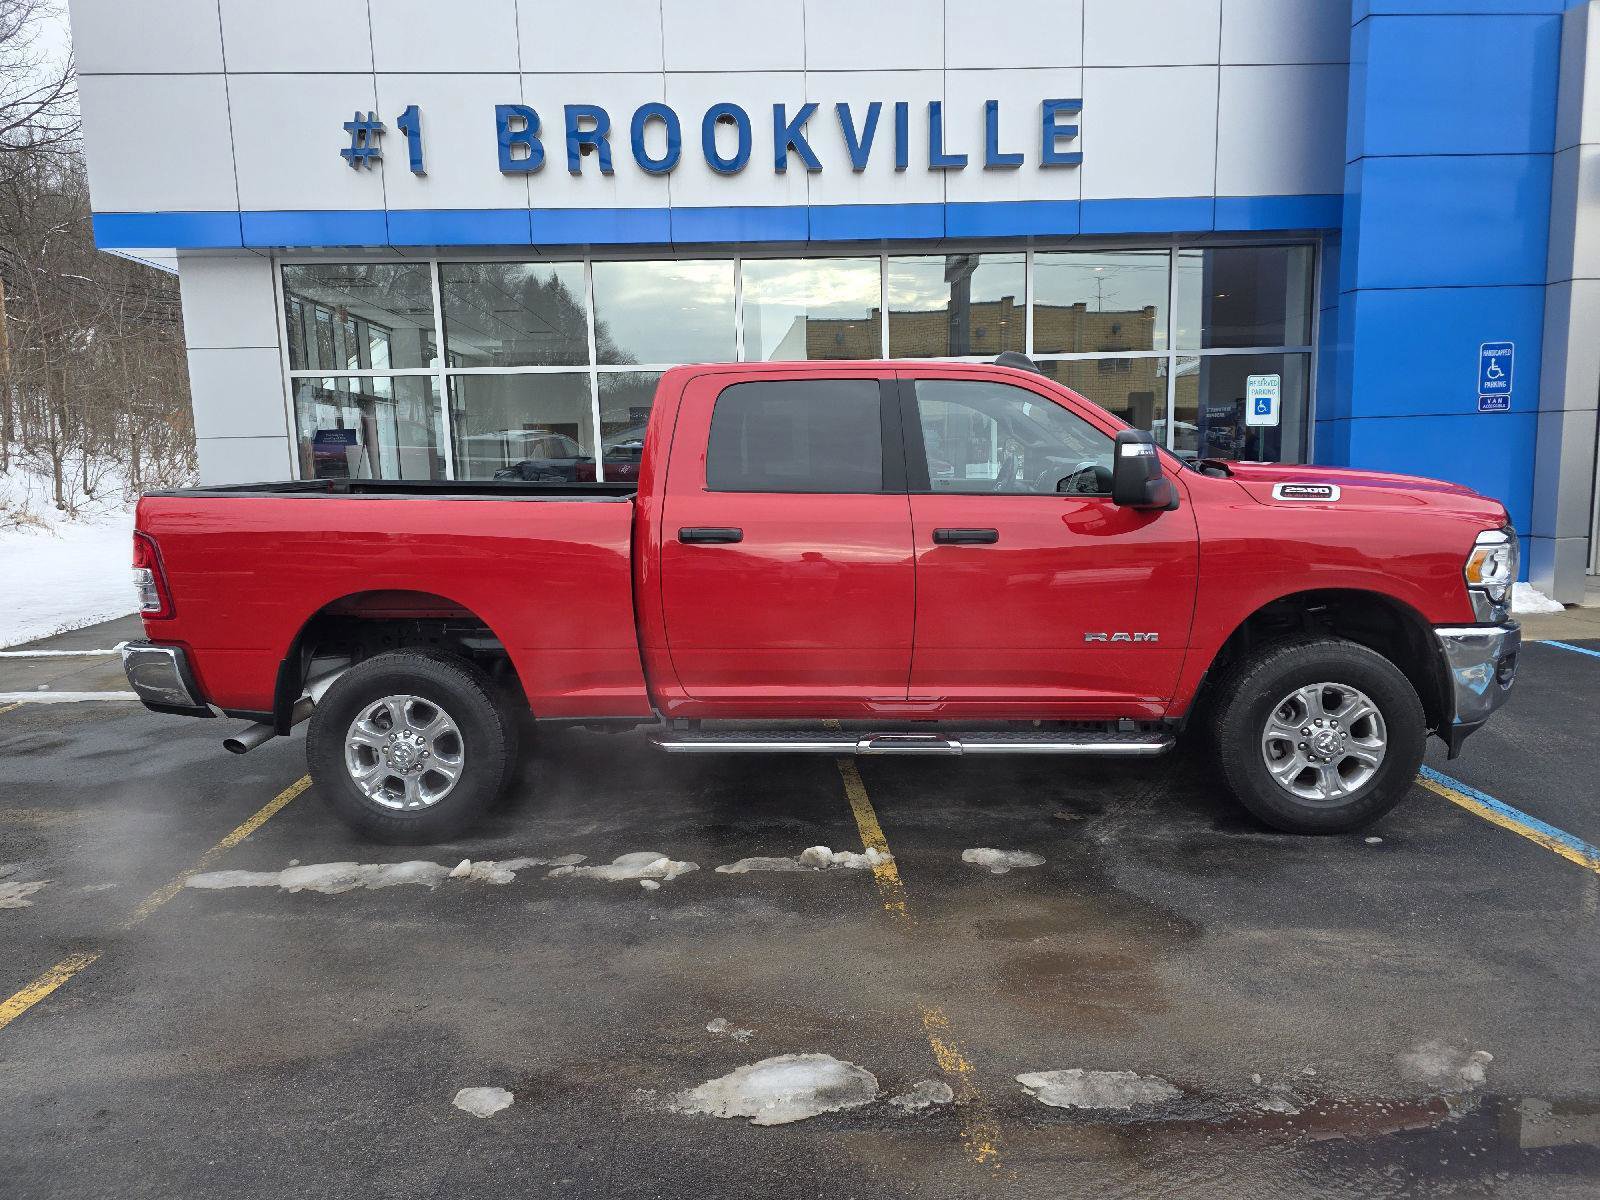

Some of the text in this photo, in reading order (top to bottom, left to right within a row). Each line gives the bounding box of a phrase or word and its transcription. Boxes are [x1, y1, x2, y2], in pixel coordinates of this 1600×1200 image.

[340, 98, 1083, 176] #1 BROOKVILLE
[1084, 633, 1158, 641] RAM
